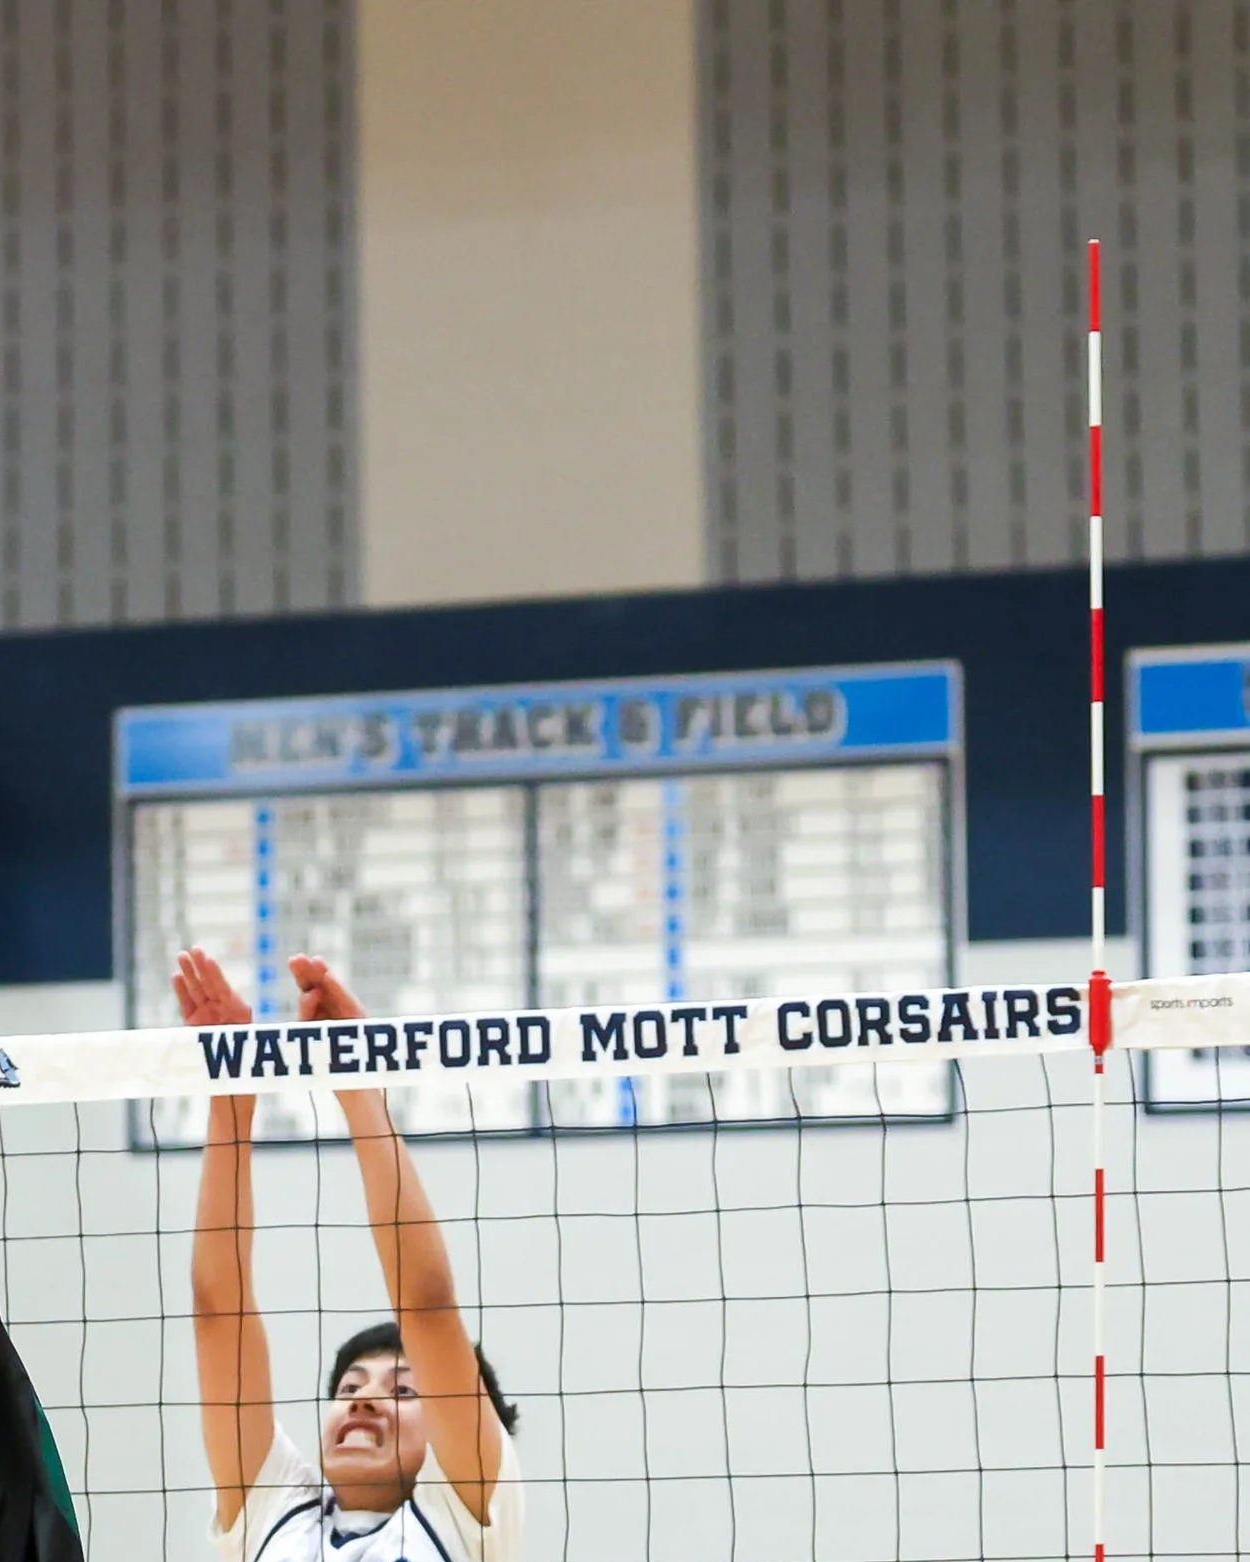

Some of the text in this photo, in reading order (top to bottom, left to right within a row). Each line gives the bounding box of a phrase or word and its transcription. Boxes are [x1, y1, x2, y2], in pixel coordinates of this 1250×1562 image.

[198, 987, 1081, 1079] WATERFORD MOTT CORSAIRS
